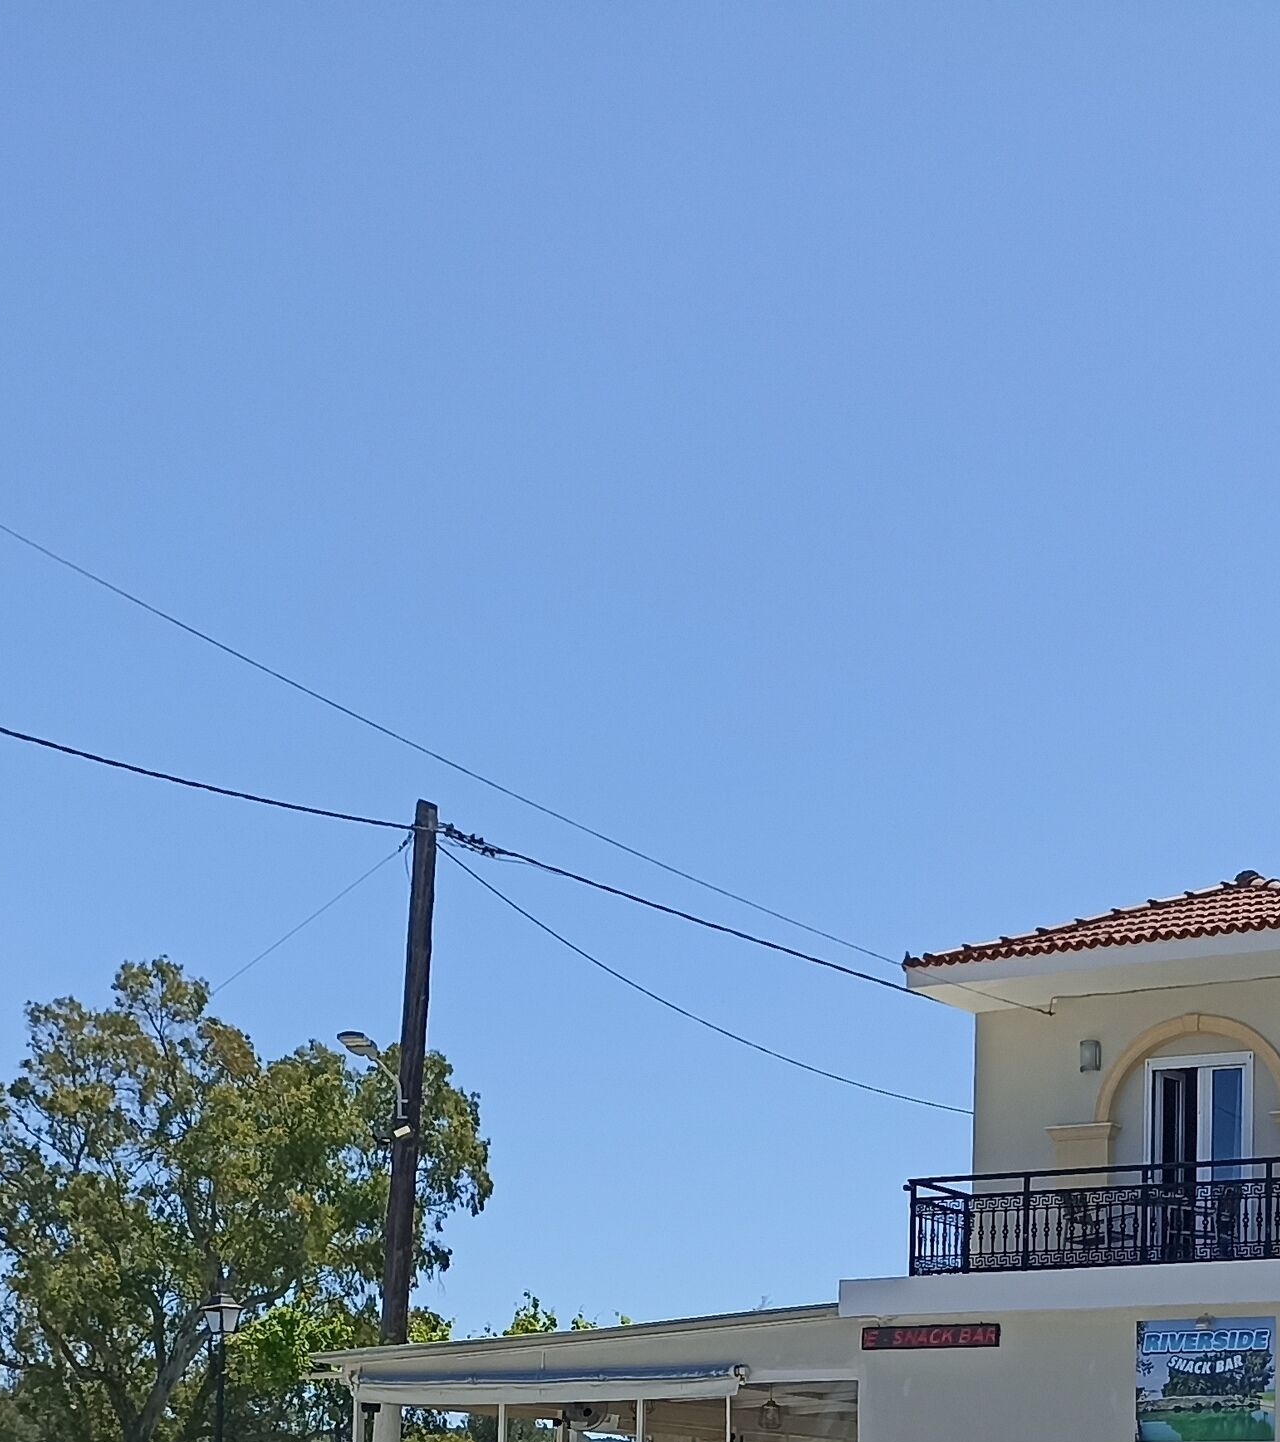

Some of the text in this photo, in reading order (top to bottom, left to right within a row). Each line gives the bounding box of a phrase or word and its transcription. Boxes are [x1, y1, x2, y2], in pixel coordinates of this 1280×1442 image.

[892, 1329, 953, 1345] SNACK
[959, 1327, 996, 1345] BAR
[1142, 1329, 1270, 1354] RIVERSIDE
[1167, 1355, 1243, 1374] SNACK BAR
